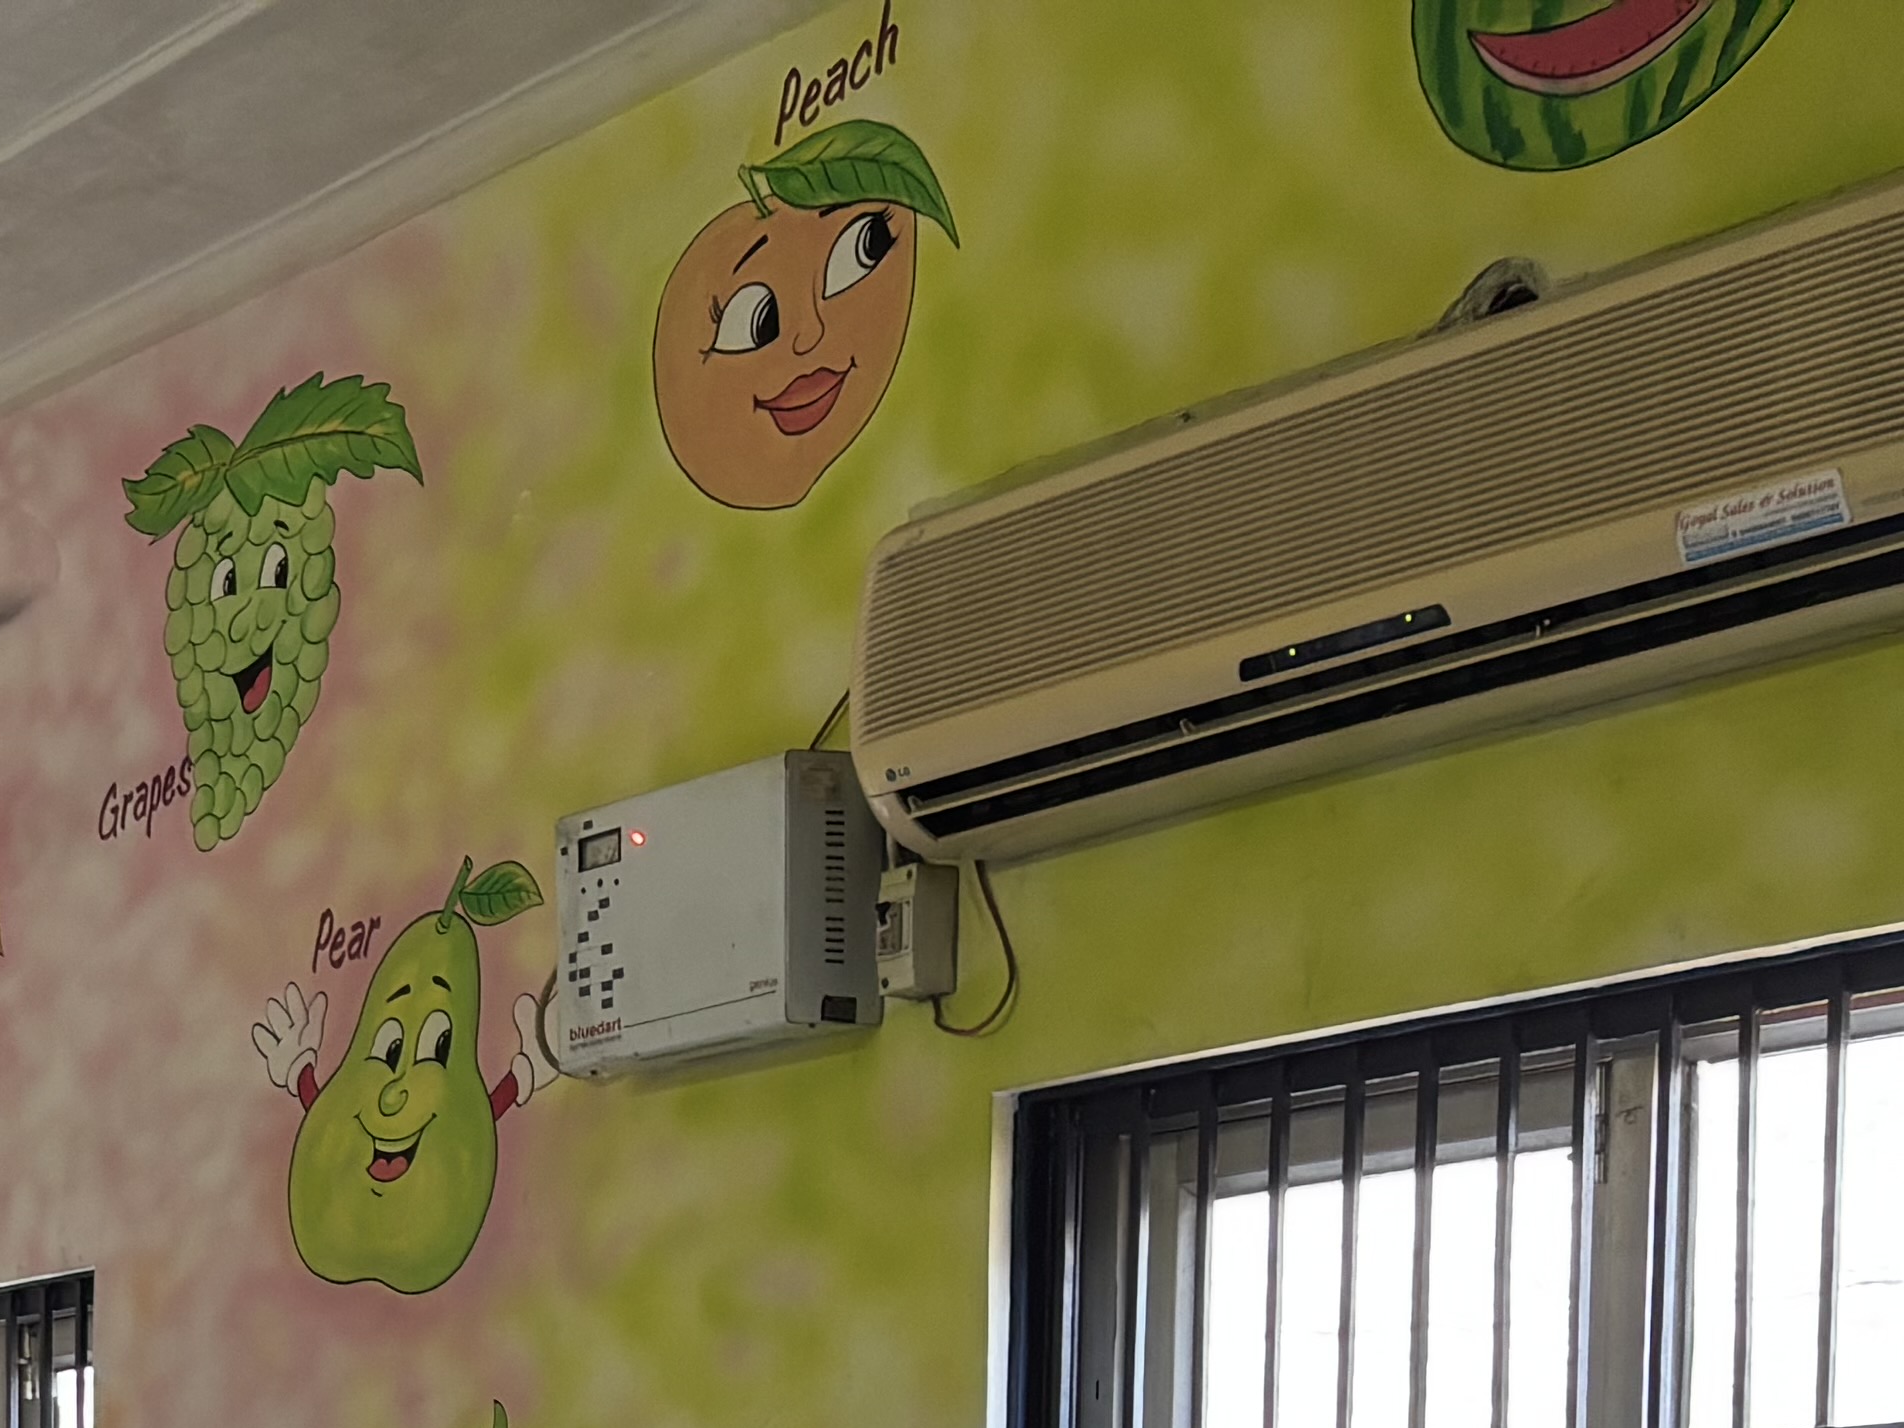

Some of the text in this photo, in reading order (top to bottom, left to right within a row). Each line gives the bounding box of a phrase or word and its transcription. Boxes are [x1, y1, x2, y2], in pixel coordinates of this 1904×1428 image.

[774, 0, 898, 146] Peach
[99, 755, 193, 840] Grapes
[312, 909, 381, 973] Pear
